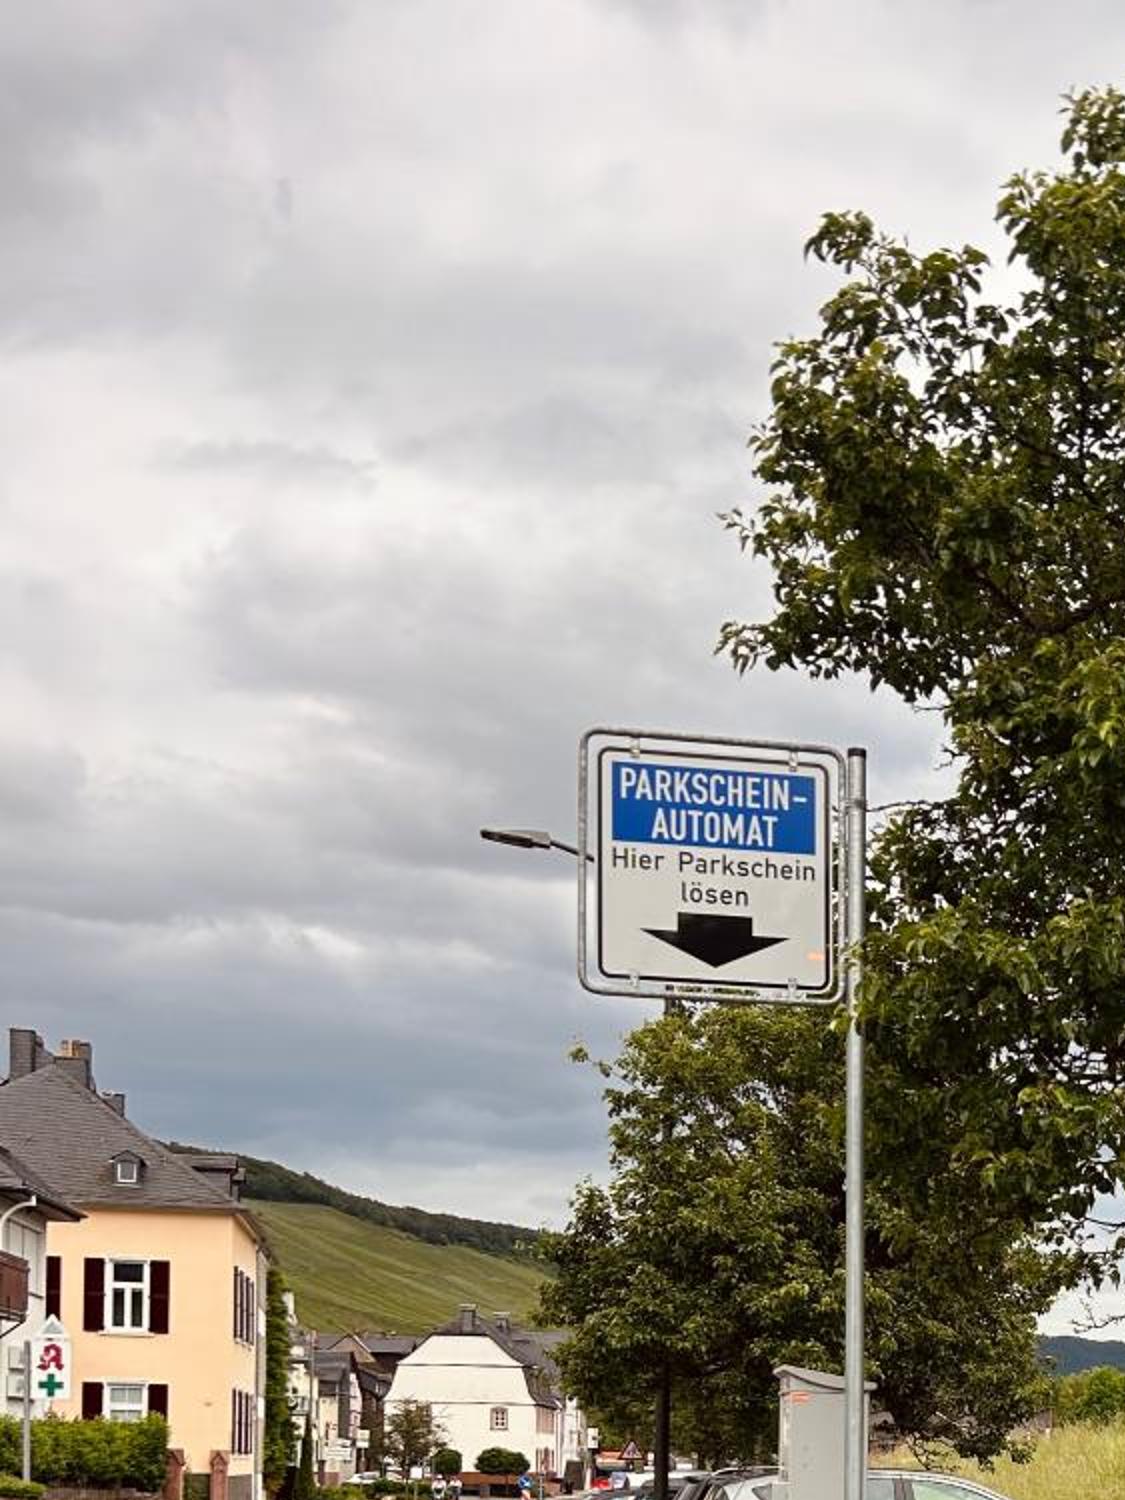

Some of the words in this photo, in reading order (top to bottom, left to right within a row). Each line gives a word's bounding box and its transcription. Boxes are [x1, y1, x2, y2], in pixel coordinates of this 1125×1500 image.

[620, 767, 808, 811] PARKSCHEIN-
[651, 808, 779, 848] AUTOMAT
[611, 847, 665, 871] Hier
[678, 851, 816, 881] Parkschein
[681, 882, 749, 906] lösen
